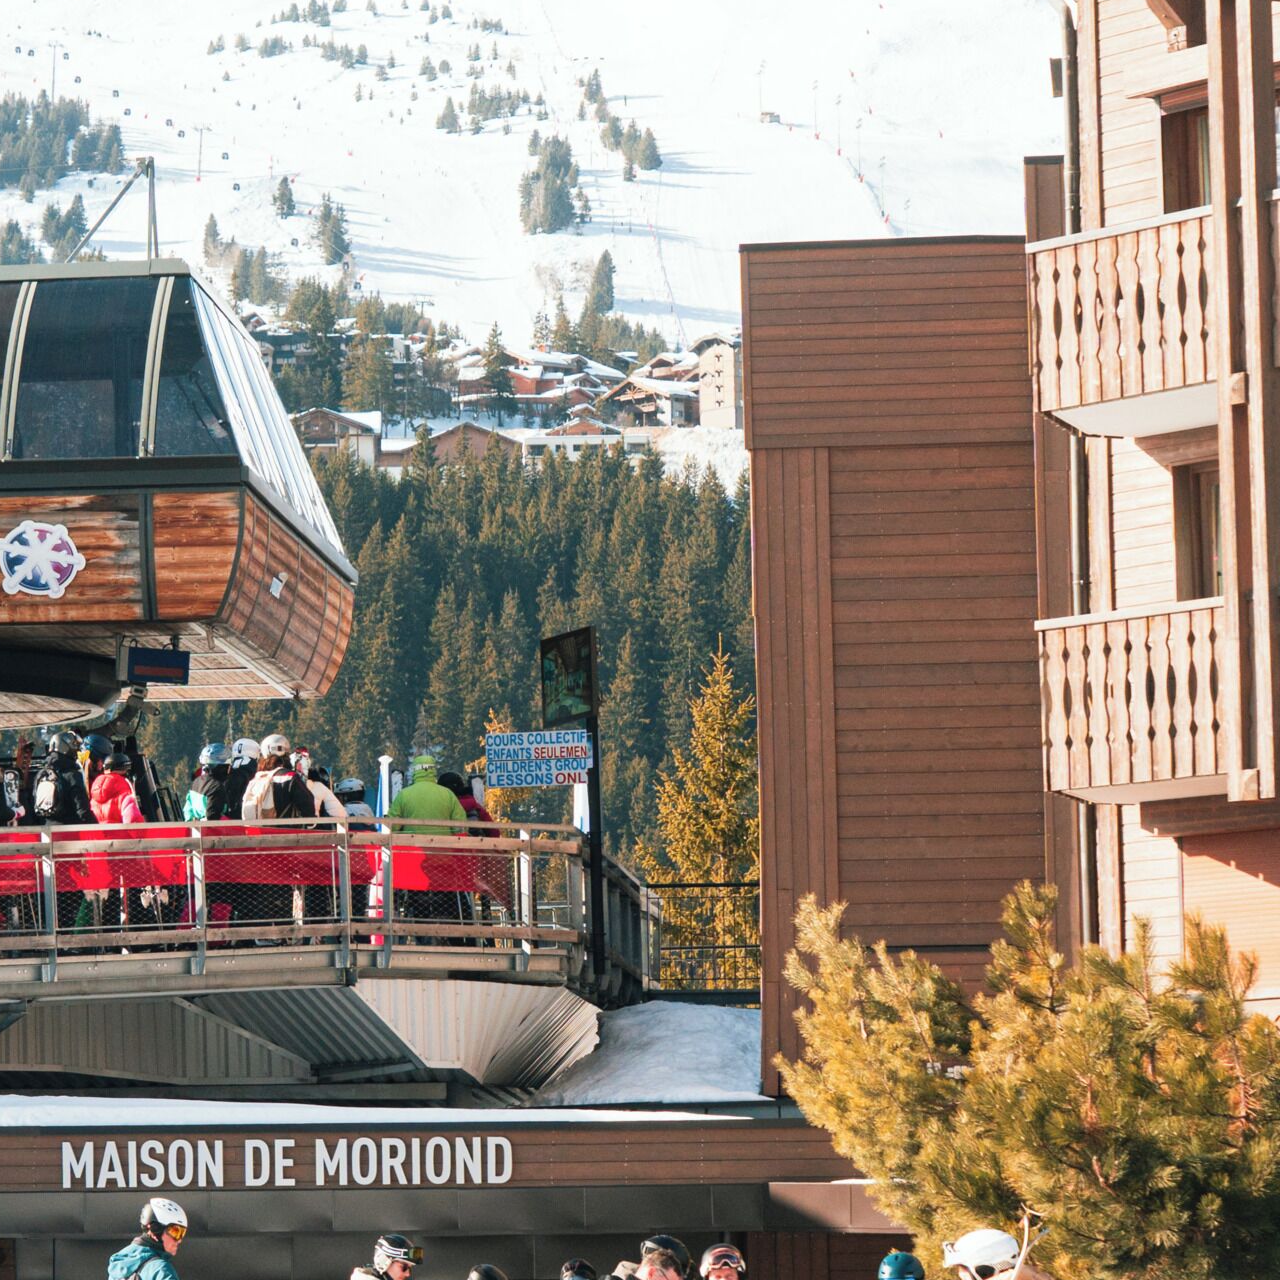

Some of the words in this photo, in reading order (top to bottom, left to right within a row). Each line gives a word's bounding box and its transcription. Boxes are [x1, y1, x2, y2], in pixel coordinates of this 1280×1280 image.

[486, 734, 524, 747] COURS
[486, 747, 532, 760] ENFANTS
[534, 746, 587, 759] SEULEMEN
[487, 760, 552, 774] CHILDREN'S
[555, 759, 587, 771] GROU
[488, 773, 553, 787] LESSONS
[555, 772, 586, 785] ONL
[61, 1139, 224, 1189] MAISON
[245, 1138, 296, 1188] DE
[315, 1135, 514, 1186] MORIOND
